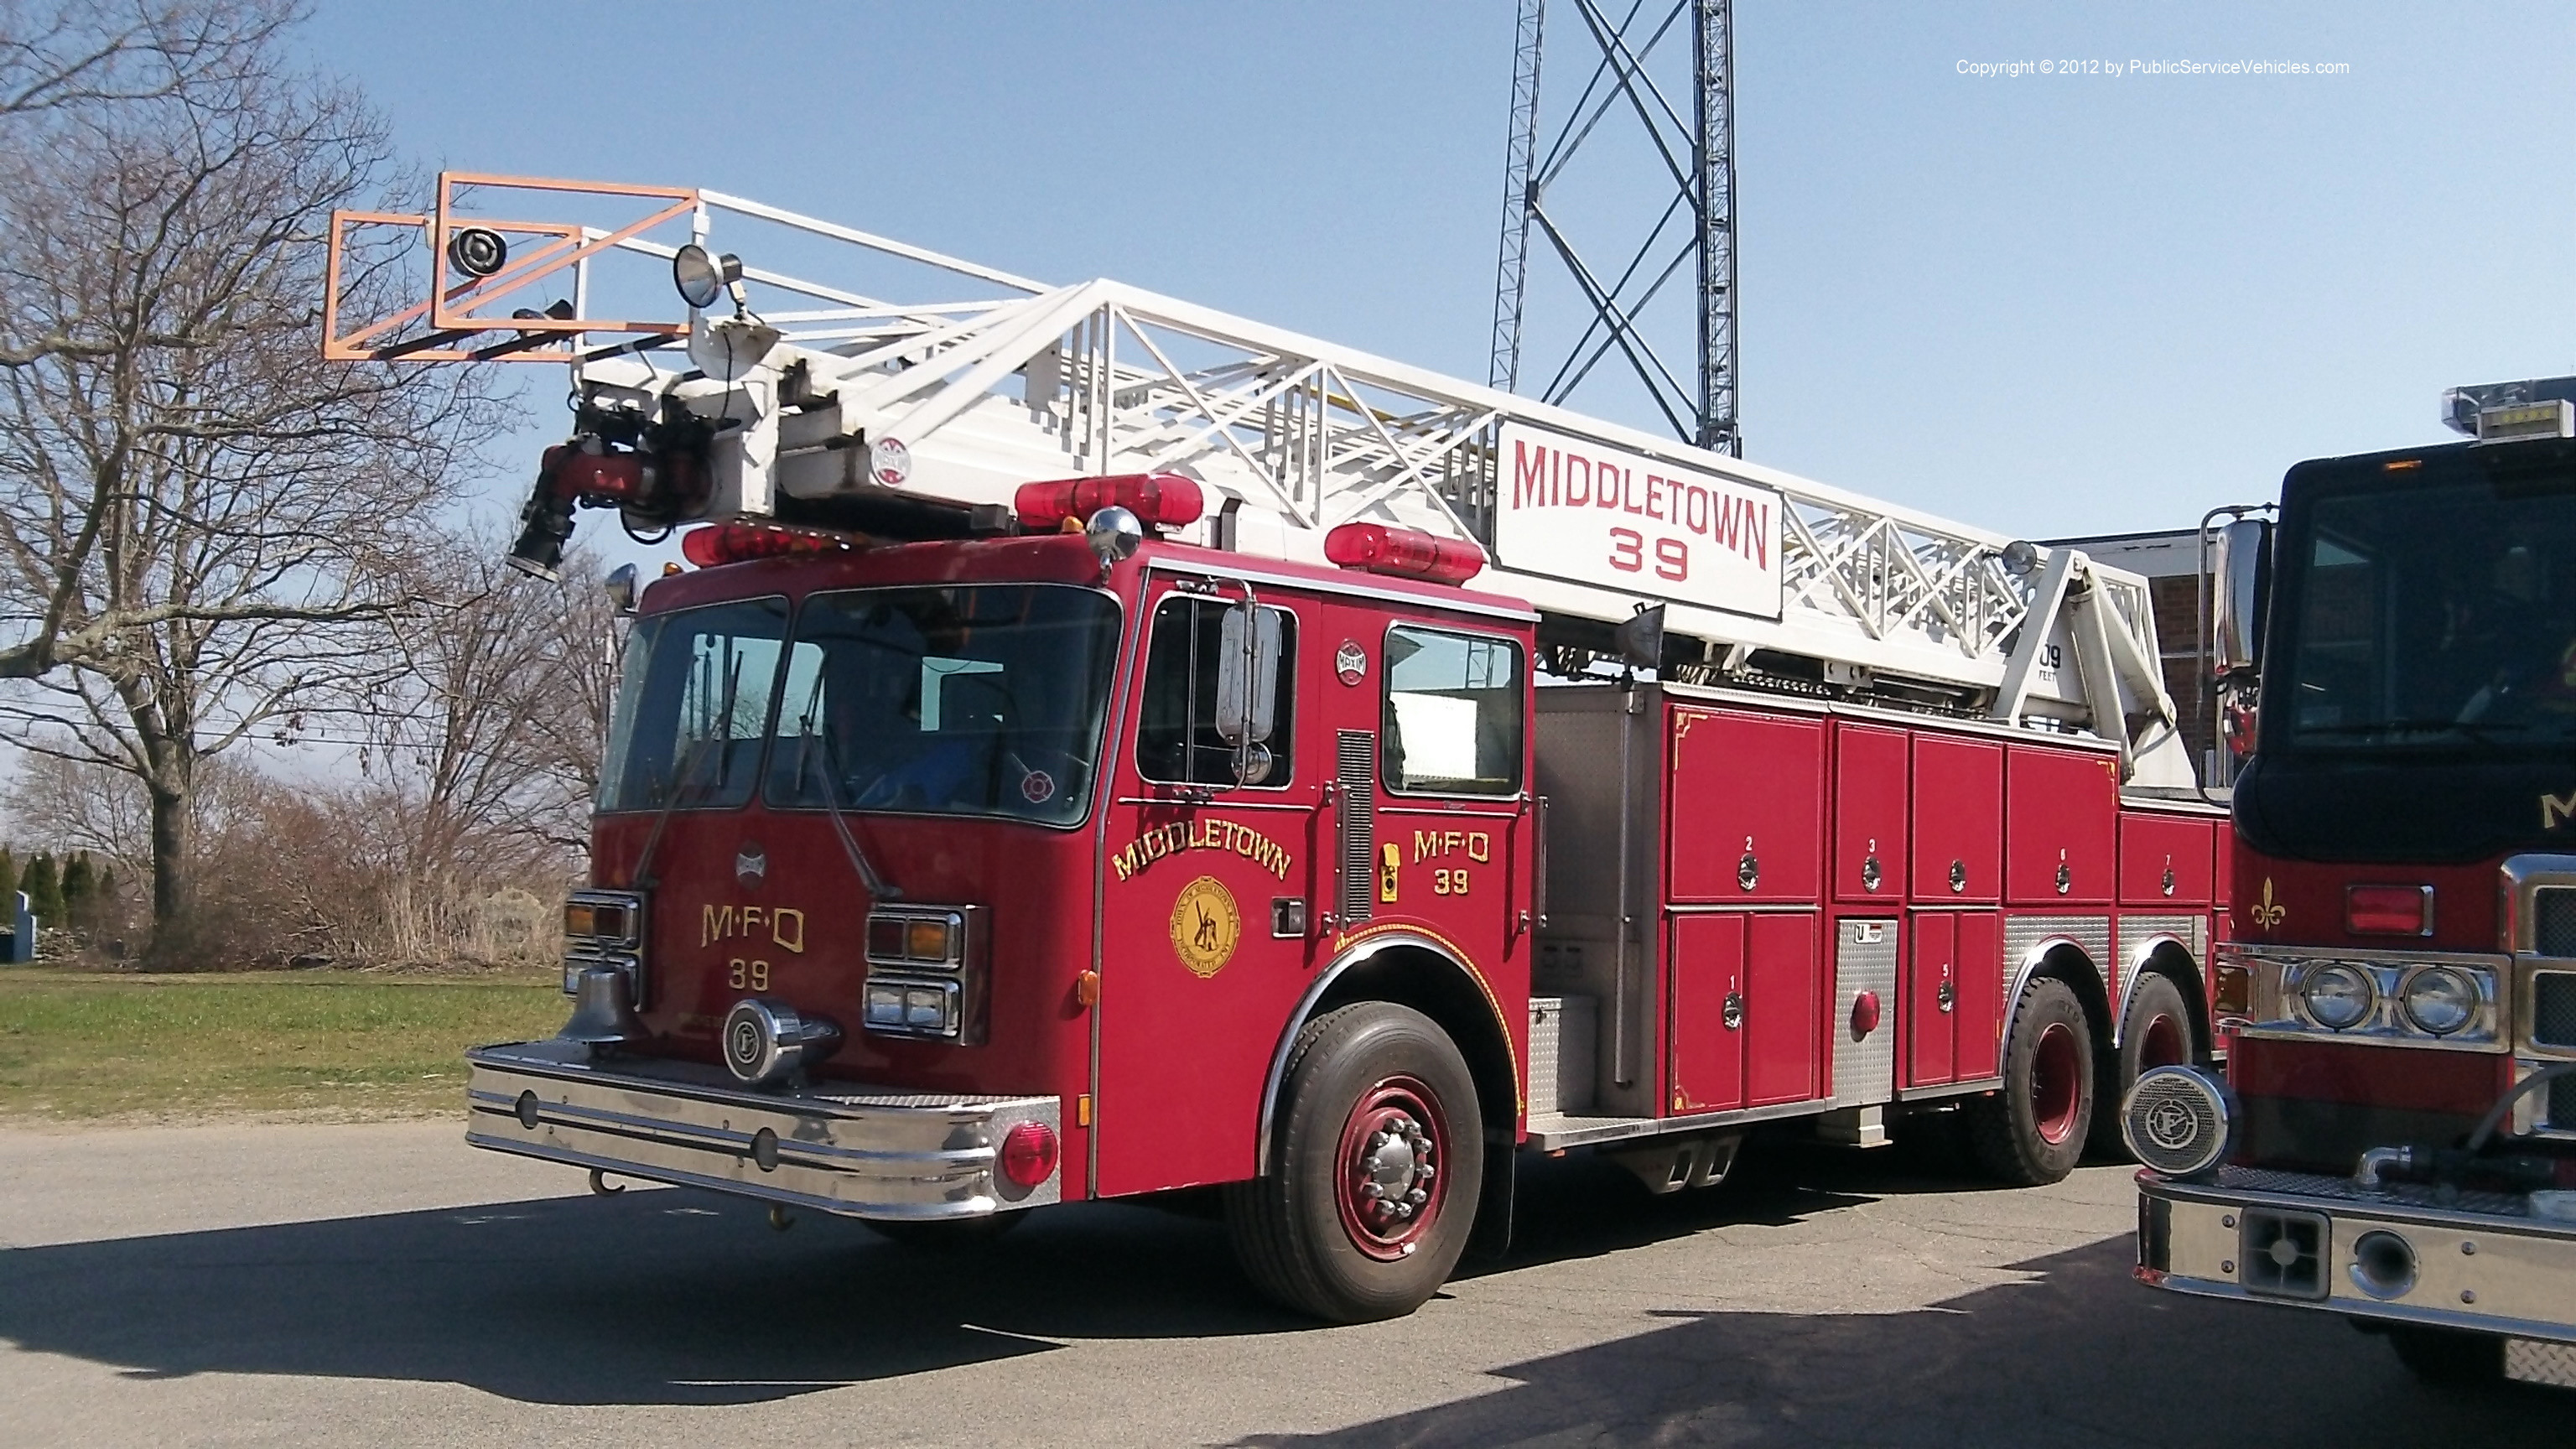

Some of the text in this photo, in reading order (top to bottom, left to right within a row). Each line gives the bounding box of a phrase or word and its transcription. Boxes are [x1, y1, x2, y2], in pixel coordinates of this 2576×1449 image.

[1512, 439, 1768, 572] MIDDLETOWN
[1608, 526, 1688, 583] 39
[1338, 652, 1366, 673] MAXIM
[1110, 818, 1293, 882] MIDDLETOWN
[1745, 835, 1753, 851] 2
[1868, 839, 1876, 853] 3
[1433, 869, 1468, 896] 39
[729, 958, 770, 992] 39
[1730, 974, 1735, 990] 1
[1942, 963, 1949, 977] 5
